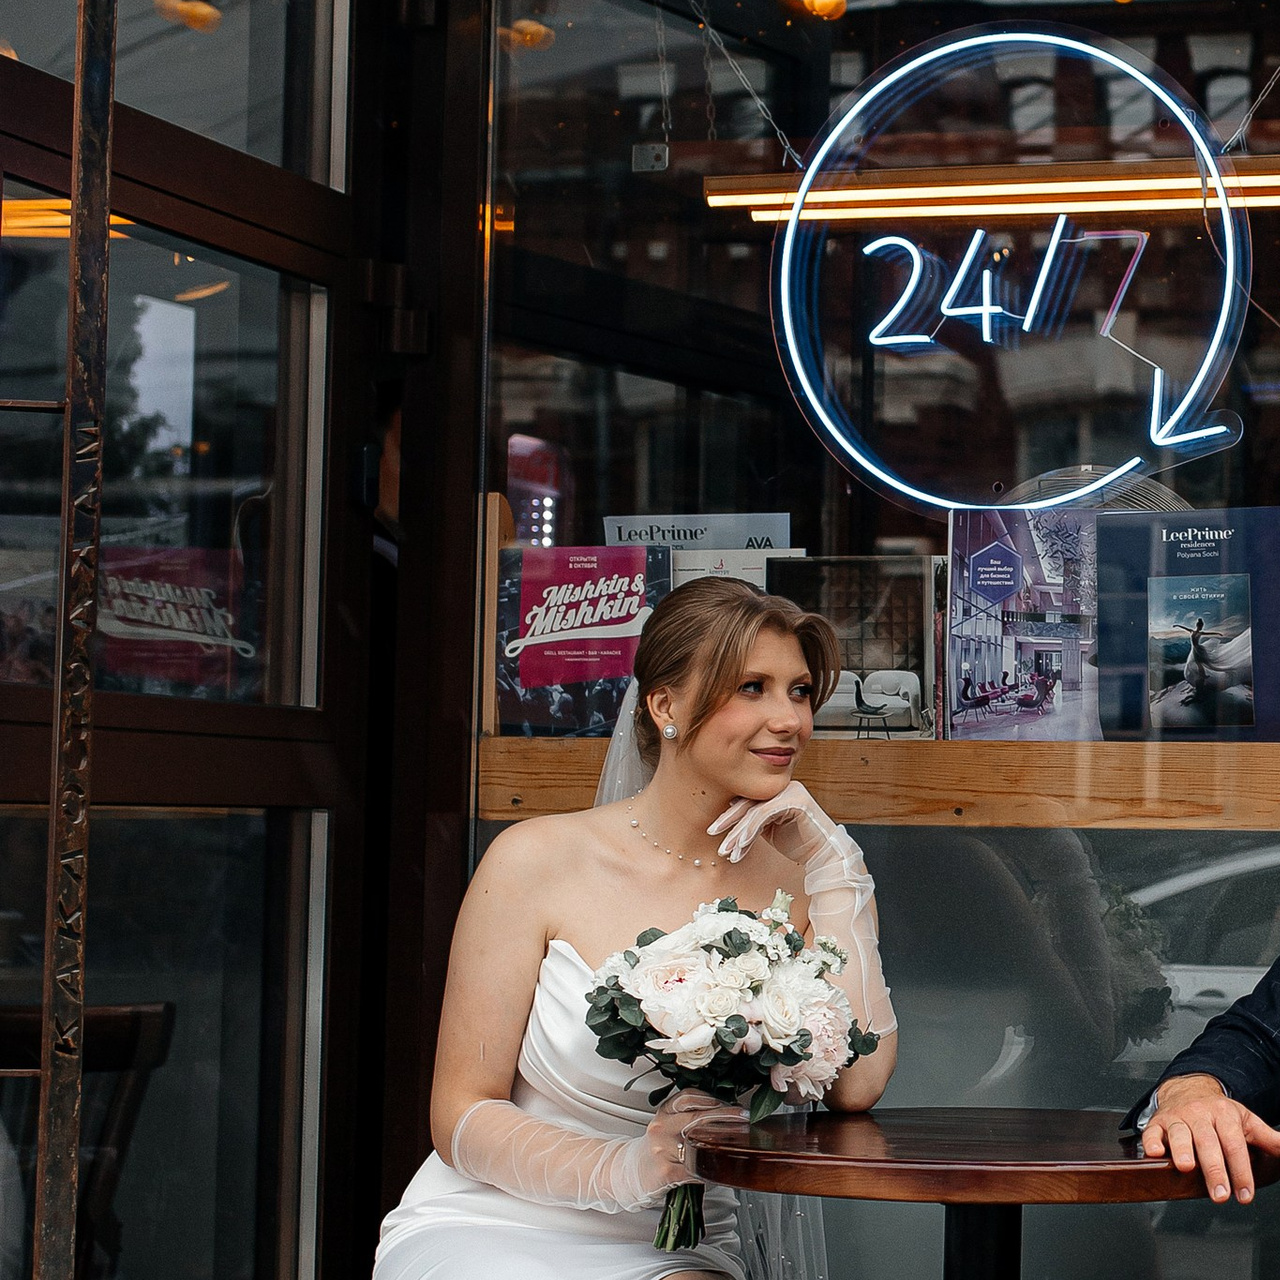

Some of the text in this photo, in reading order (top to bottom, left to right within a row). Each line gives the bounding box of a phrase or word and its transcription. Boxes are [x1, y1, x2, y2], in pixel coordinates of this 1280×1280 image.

[862, 214, 1150, 344] 24/7
[745, 536, 774, 550] AVA
[1176, 550, 1219, 559] Polyana Sochi
[1180, 540, 1216, 549] residences
[535, 572, 646, 611] Mishkin &
[518, 592, 642, 640] Mishkin
